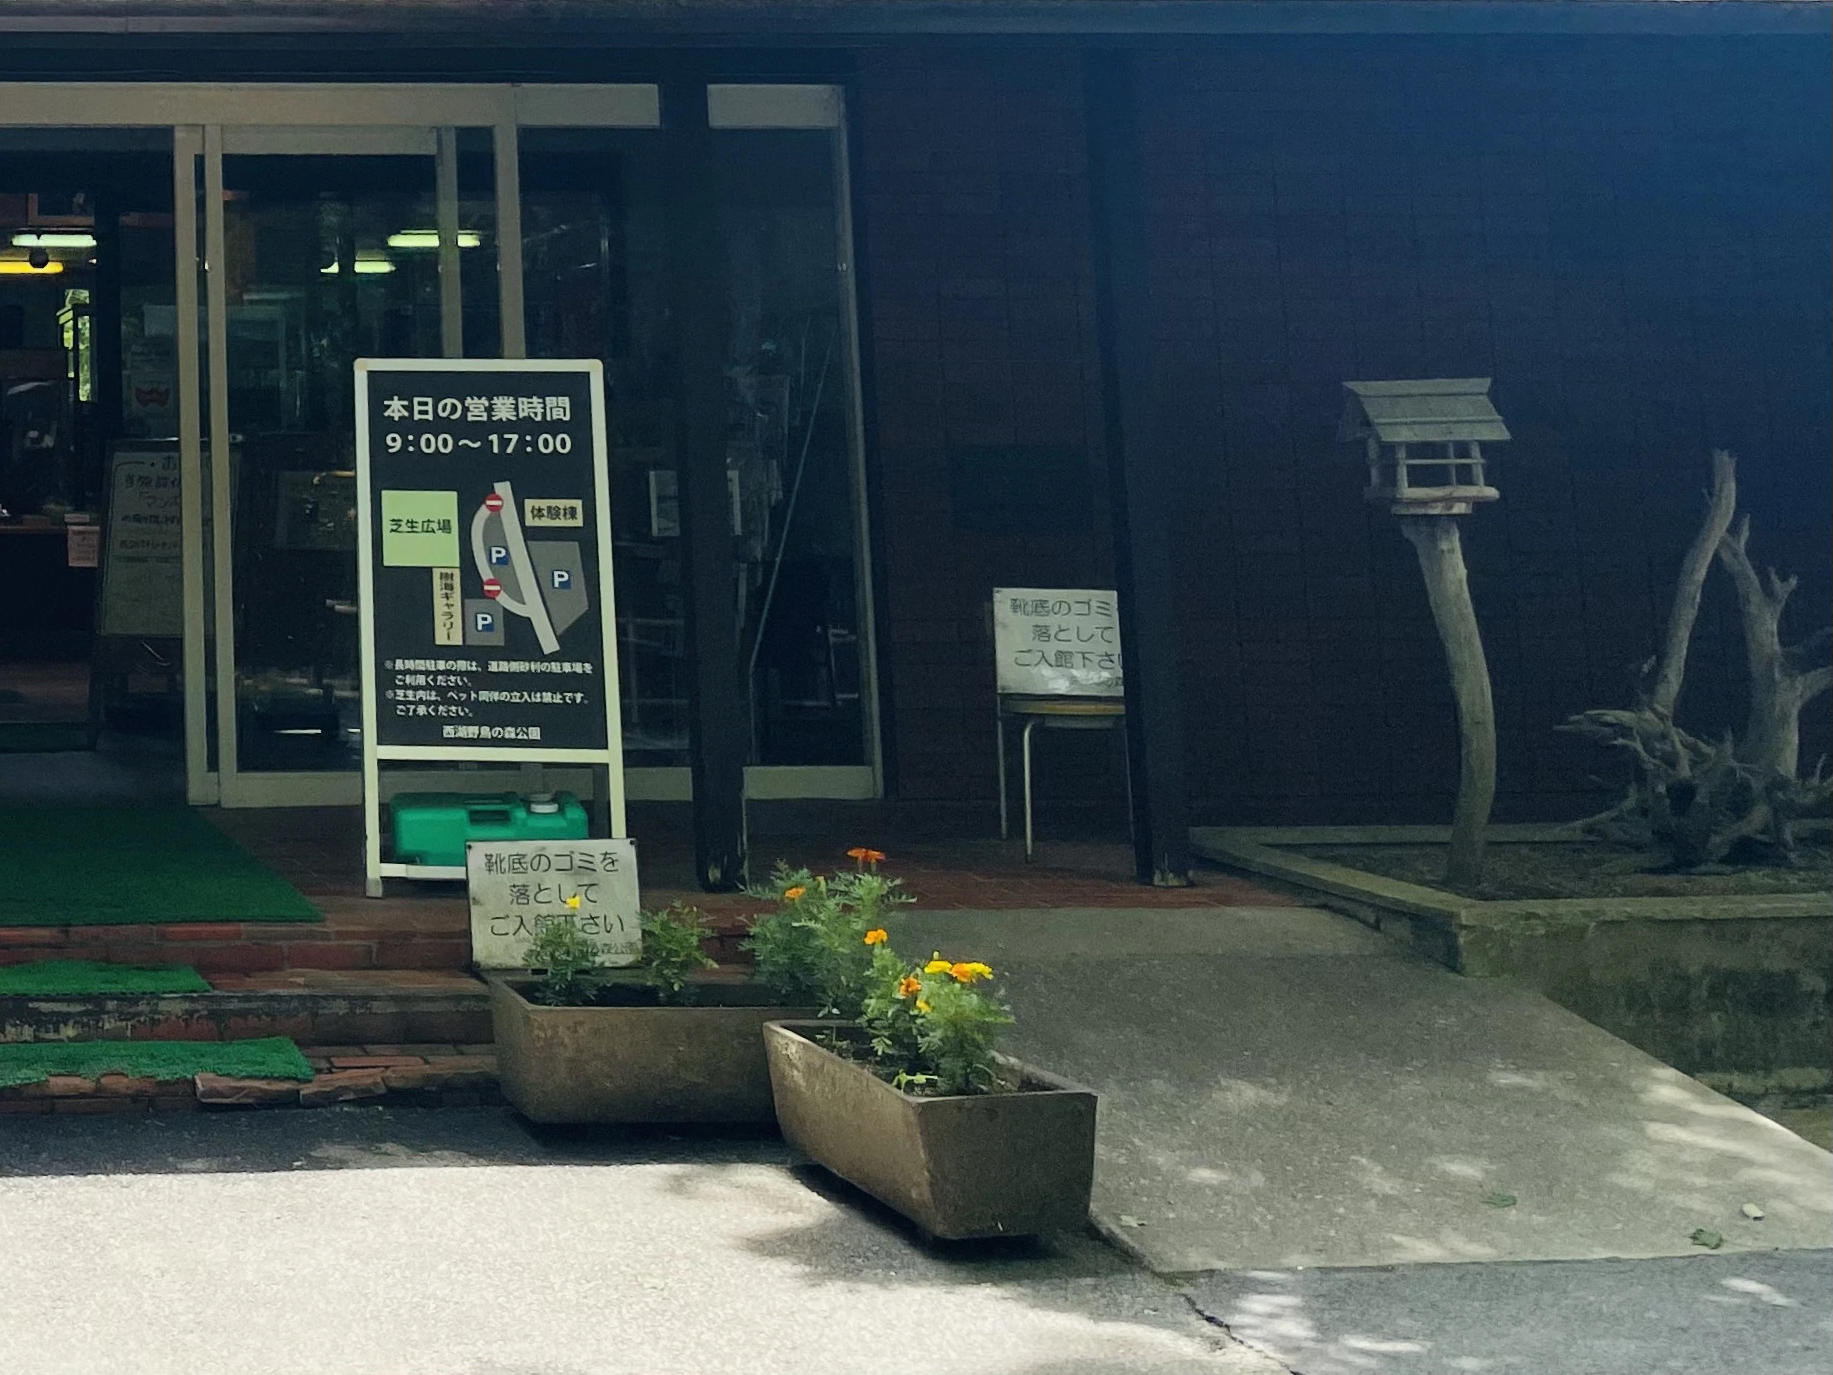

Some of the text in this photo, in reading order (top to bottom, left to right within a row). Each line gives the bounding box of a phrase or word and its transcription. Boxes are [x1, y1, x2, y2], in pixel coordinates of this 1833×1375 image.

[383, 395, 571, 422] 本日の営業時間
[530, 504, 578, 522] 体験棟
[389, 518, 452, 535] 芝生広場
[490, 546, 507, 564] P
[553, 570, 570, 588] P
[439, 571, 455, 641] 樹海ギャラリー
[1010, 598, 1112, 617] 靴底のゴミ
[476, 613, 493, 631] P
[1032, 624, 1115, 643] 落として
[394, 674, 472, 687] ご利用ください。
[395, 704, 474, 718] ご了承ください。
[442, 725, 541, 740] 西湖野鳥の森公園
[484, 852, 619, 875] 靴底のゴミを
[509, 882, 599, 906] 落として
